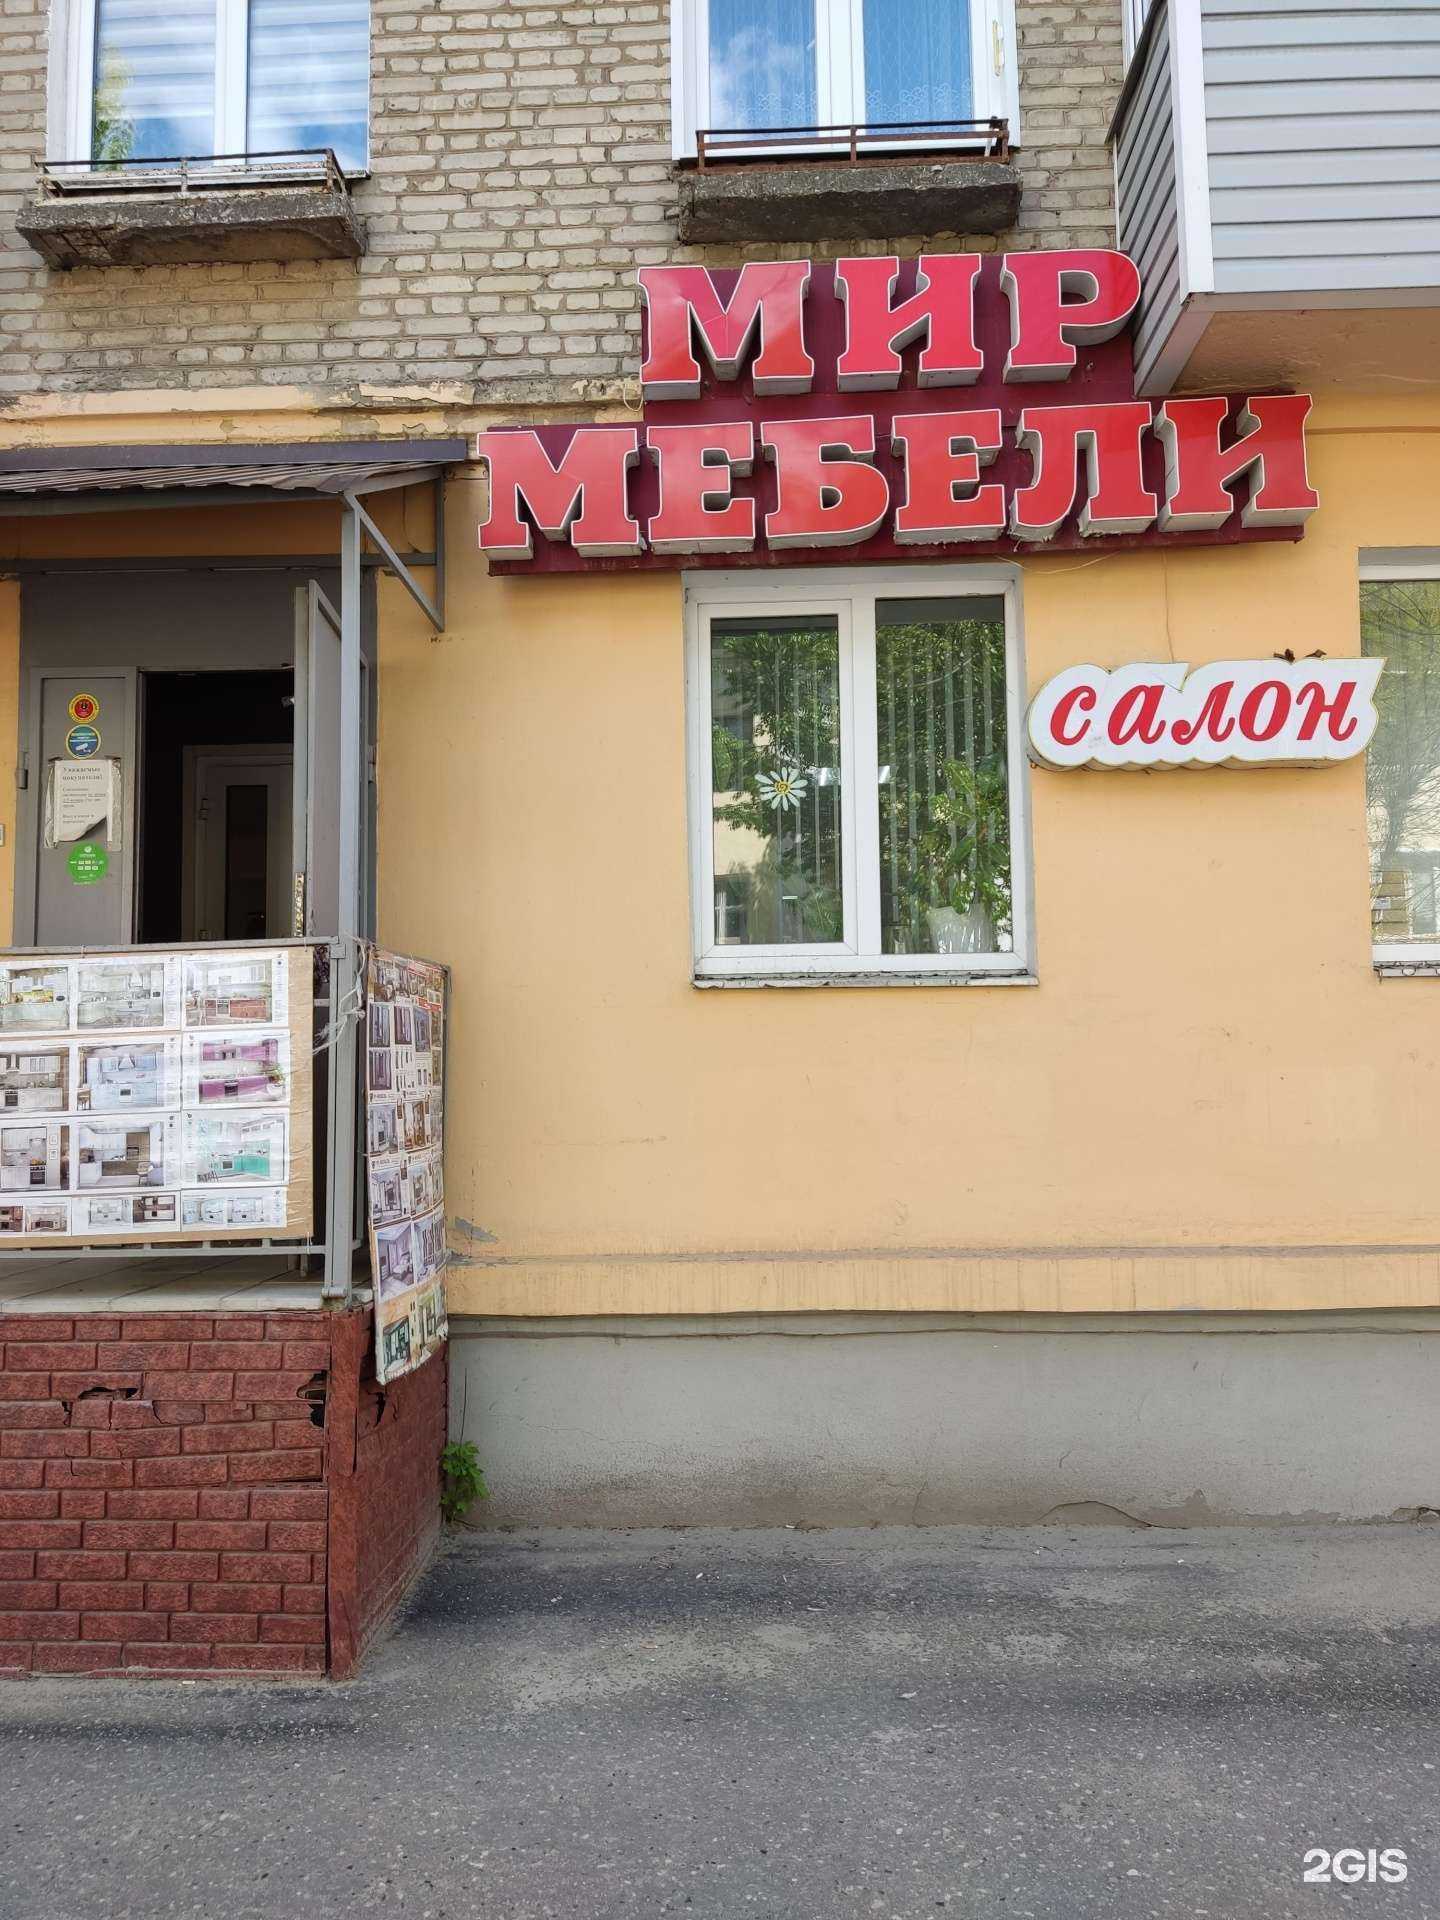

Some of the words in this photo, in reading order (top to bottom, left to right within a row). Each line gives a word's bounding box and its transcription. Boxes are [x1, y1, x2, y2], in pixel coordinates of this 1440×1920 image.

[638, 249, 1142, 400] МИР
[477, 394, 1319, 559] МЕБЕЛИ
[1049, 679, 1358, 745] салон
